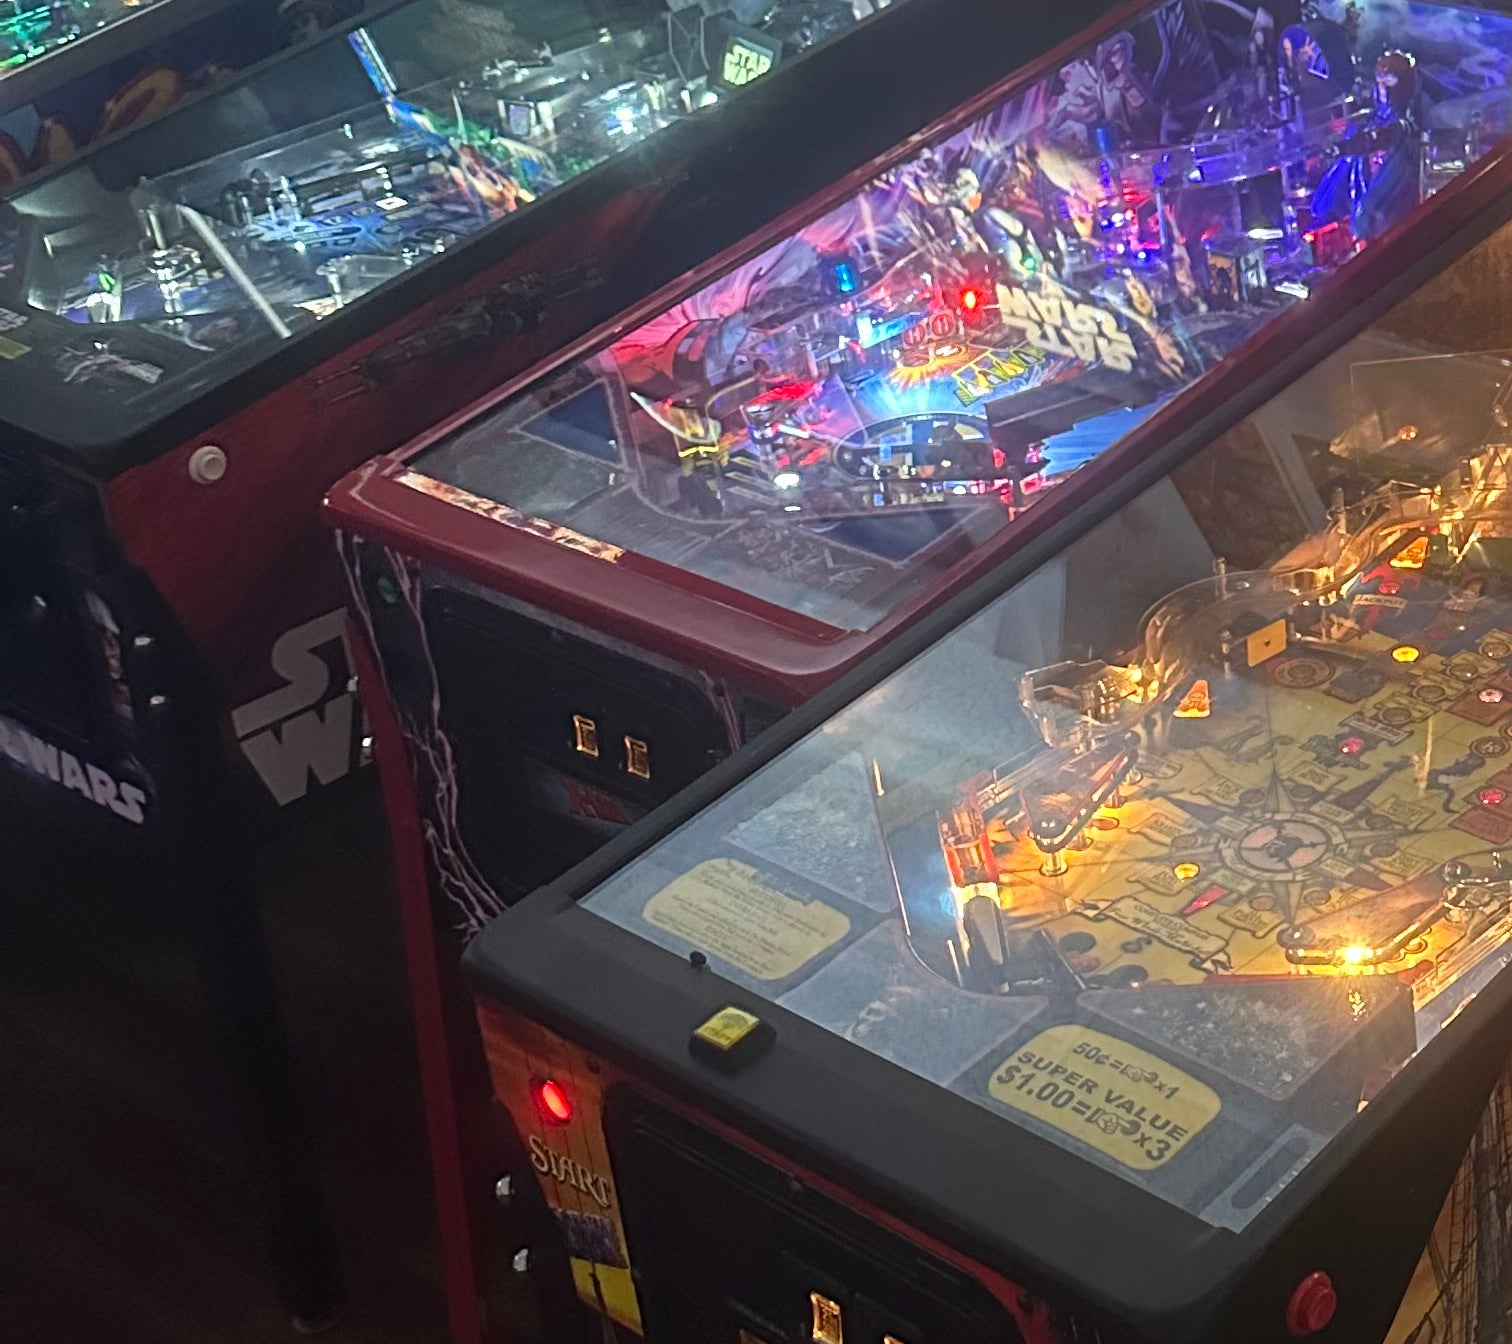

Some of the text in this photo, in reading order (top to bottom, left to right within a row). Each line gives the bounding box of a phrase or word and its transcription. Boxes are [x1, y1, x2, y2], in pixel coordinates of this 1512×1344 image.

[24, 732, 147, 825] WARS
[1017, 1051, 1189, 1143] SUPER VALUE
[529, 1135, 610, 1208] START
